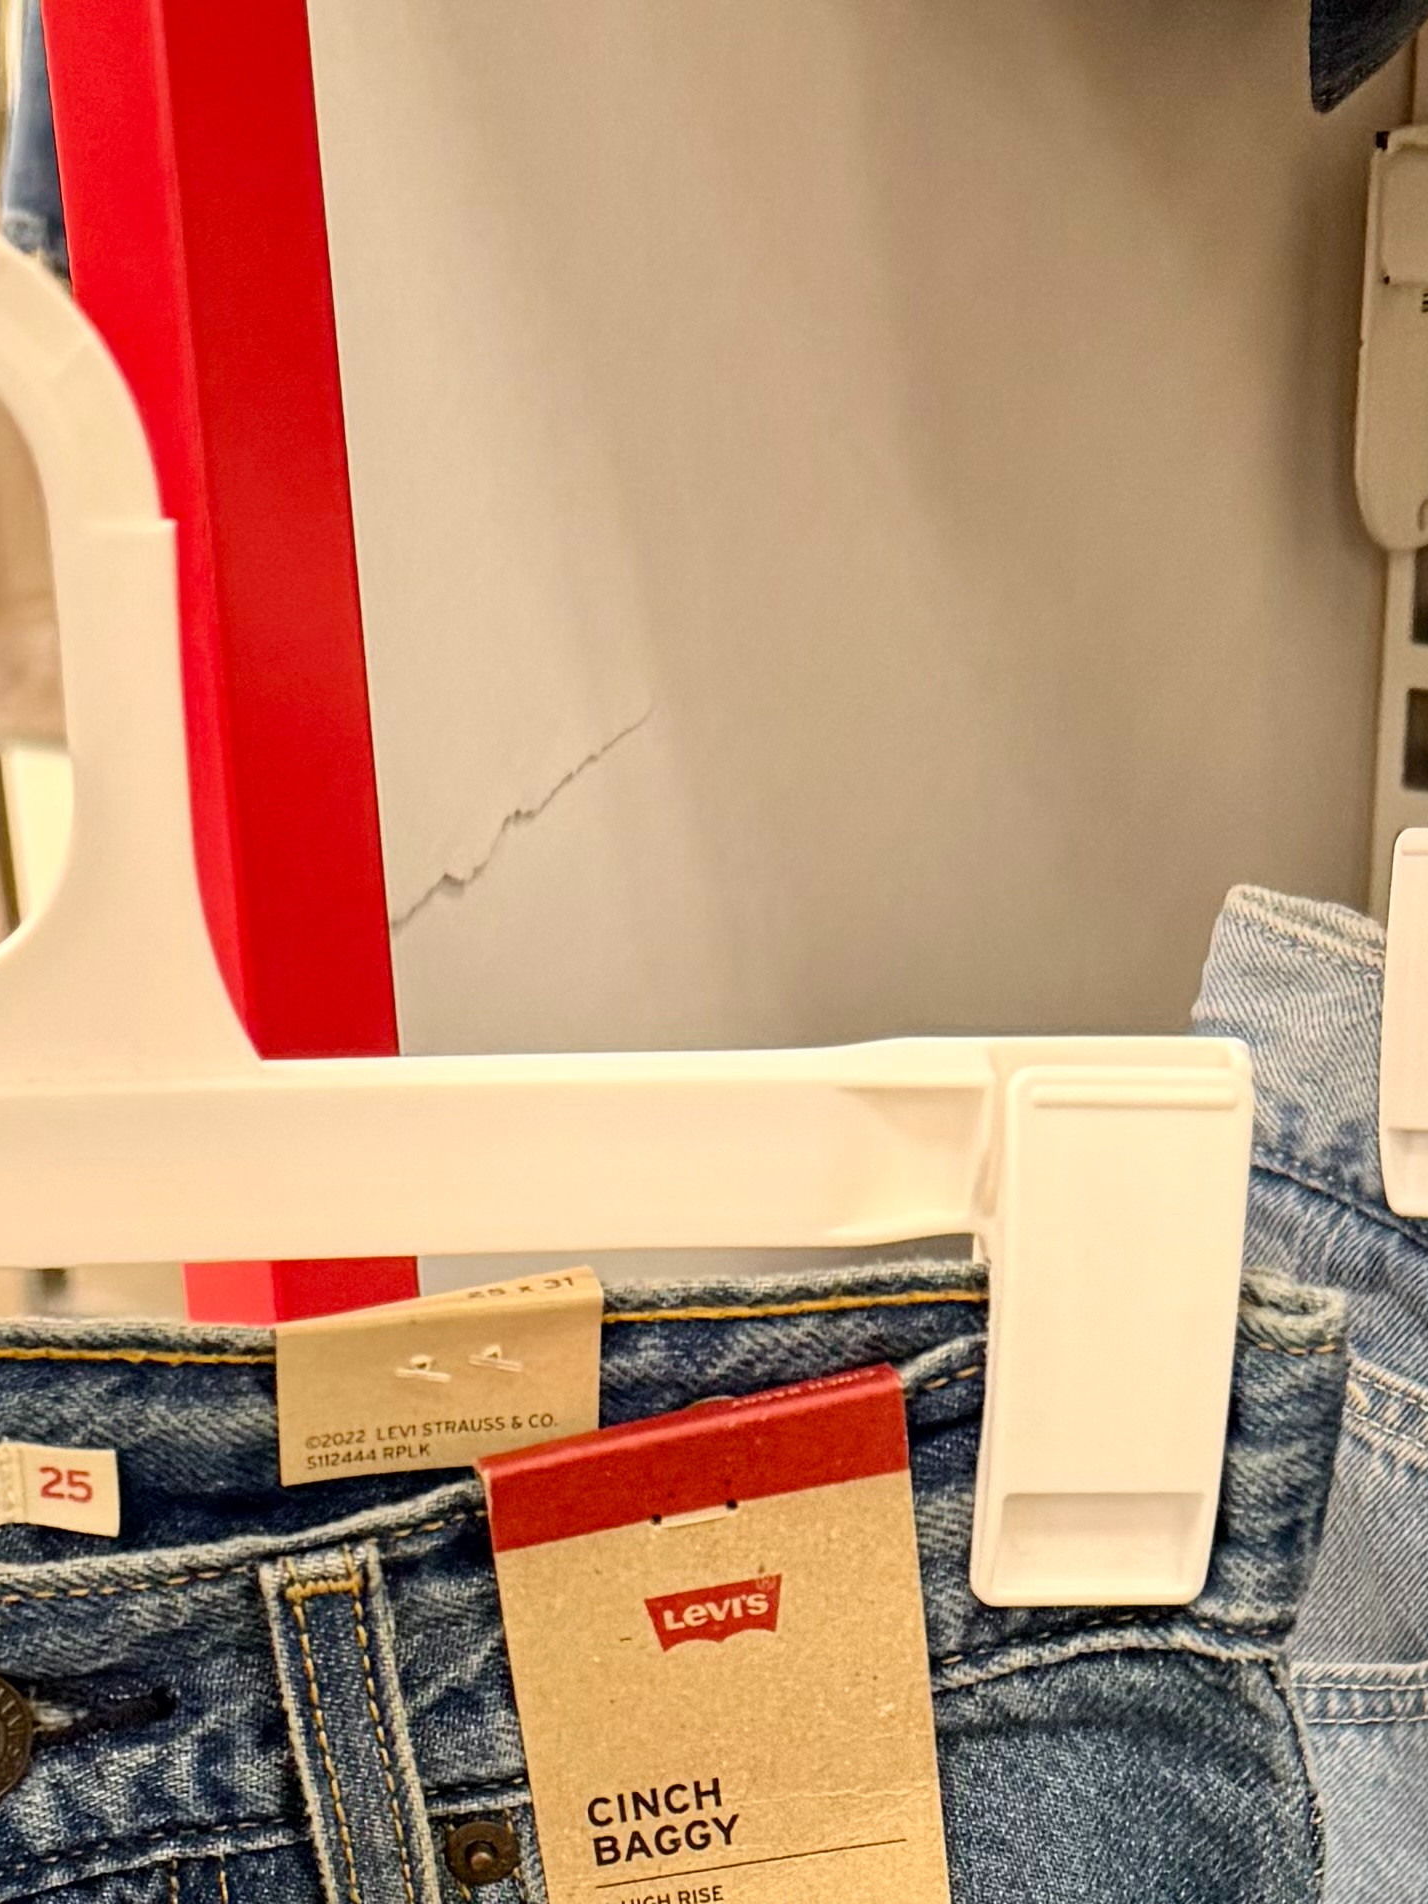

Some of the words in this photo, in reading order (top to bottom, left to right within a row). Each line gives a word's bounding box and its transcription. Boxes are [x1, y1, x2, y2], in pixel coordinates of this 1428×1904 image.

[377, 1425, 417, 1442] LEVI
[422, 1416, 511, 1437] STRAUSS
[511, 1416, 523, 1430] &
[528, 1413, 559, 1429] CO.
[307, 1449, 377, 1470] S112444
[383, 1443, 431, 1460] RPLK
[38, 1466, 94, 1504] 25
[587, 1777, 722, 1827] CINCH
[592, 1813, 740, 1867] BAGGY
